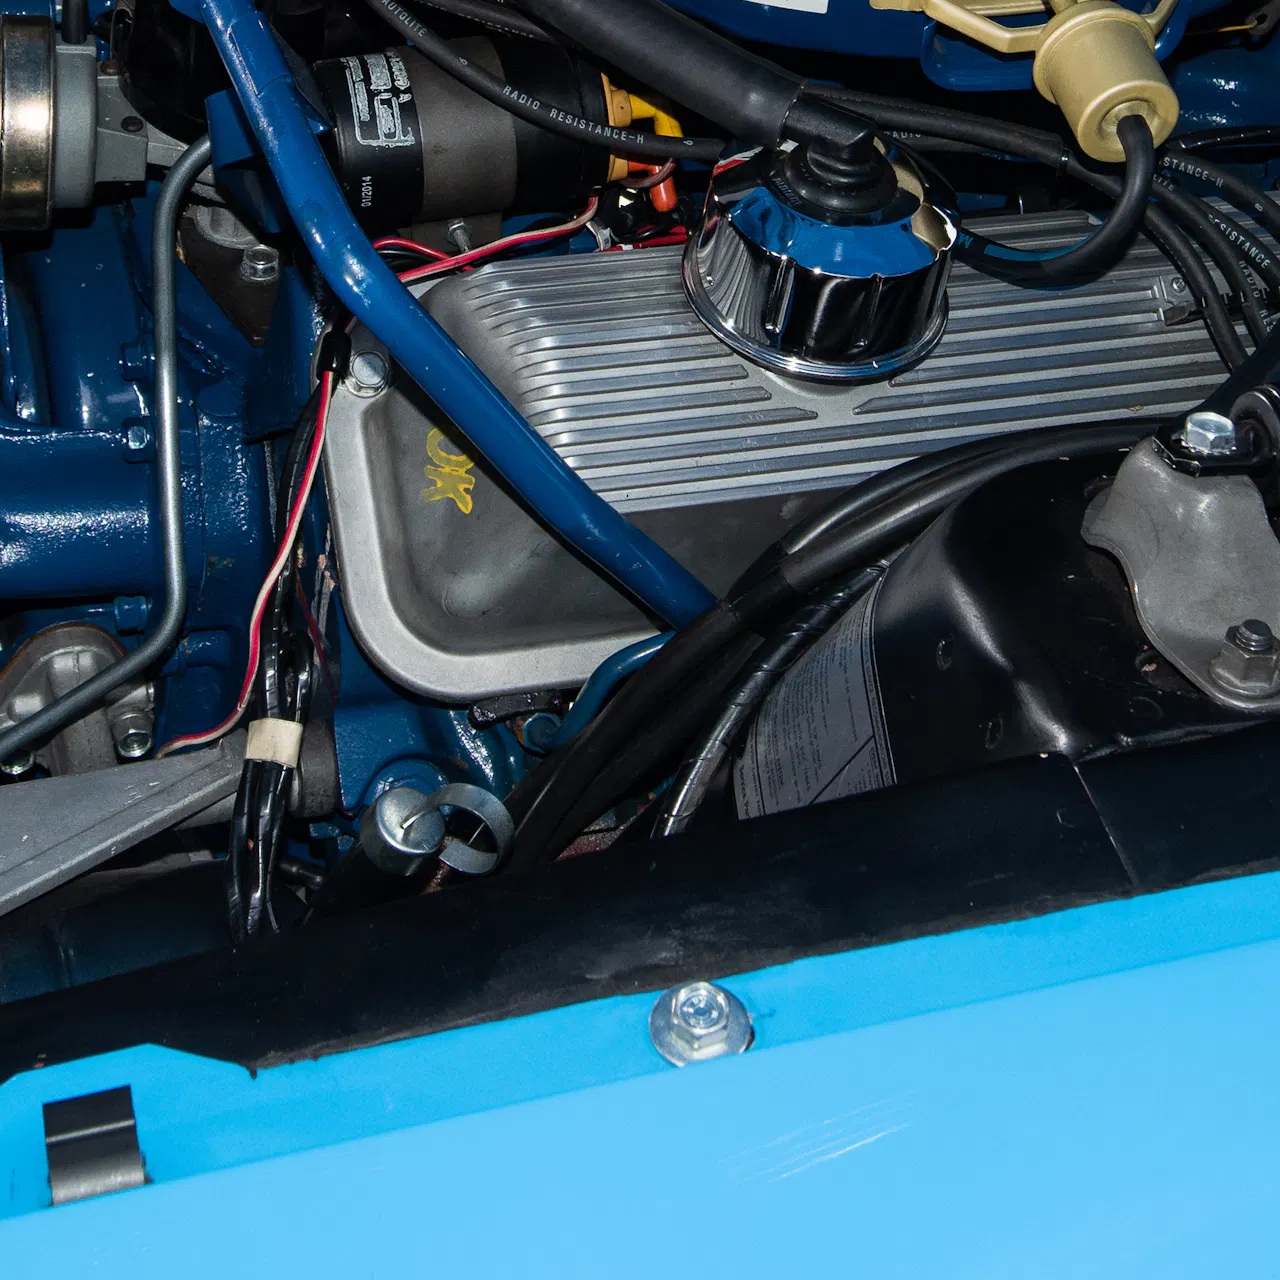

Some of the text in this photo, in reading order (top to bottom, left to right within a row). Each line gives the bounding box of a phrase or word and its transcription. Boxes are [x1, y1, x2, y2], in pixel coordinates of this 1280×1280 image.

[502, 84, 541, 111] RADIO
[549, 107, 645, 145] RESISTANCE-H
[360, 176, 373, 208] 01/2014
[1158, 156, 1225, 189] STANCE-H
[420, 428, 476, 515] OK
